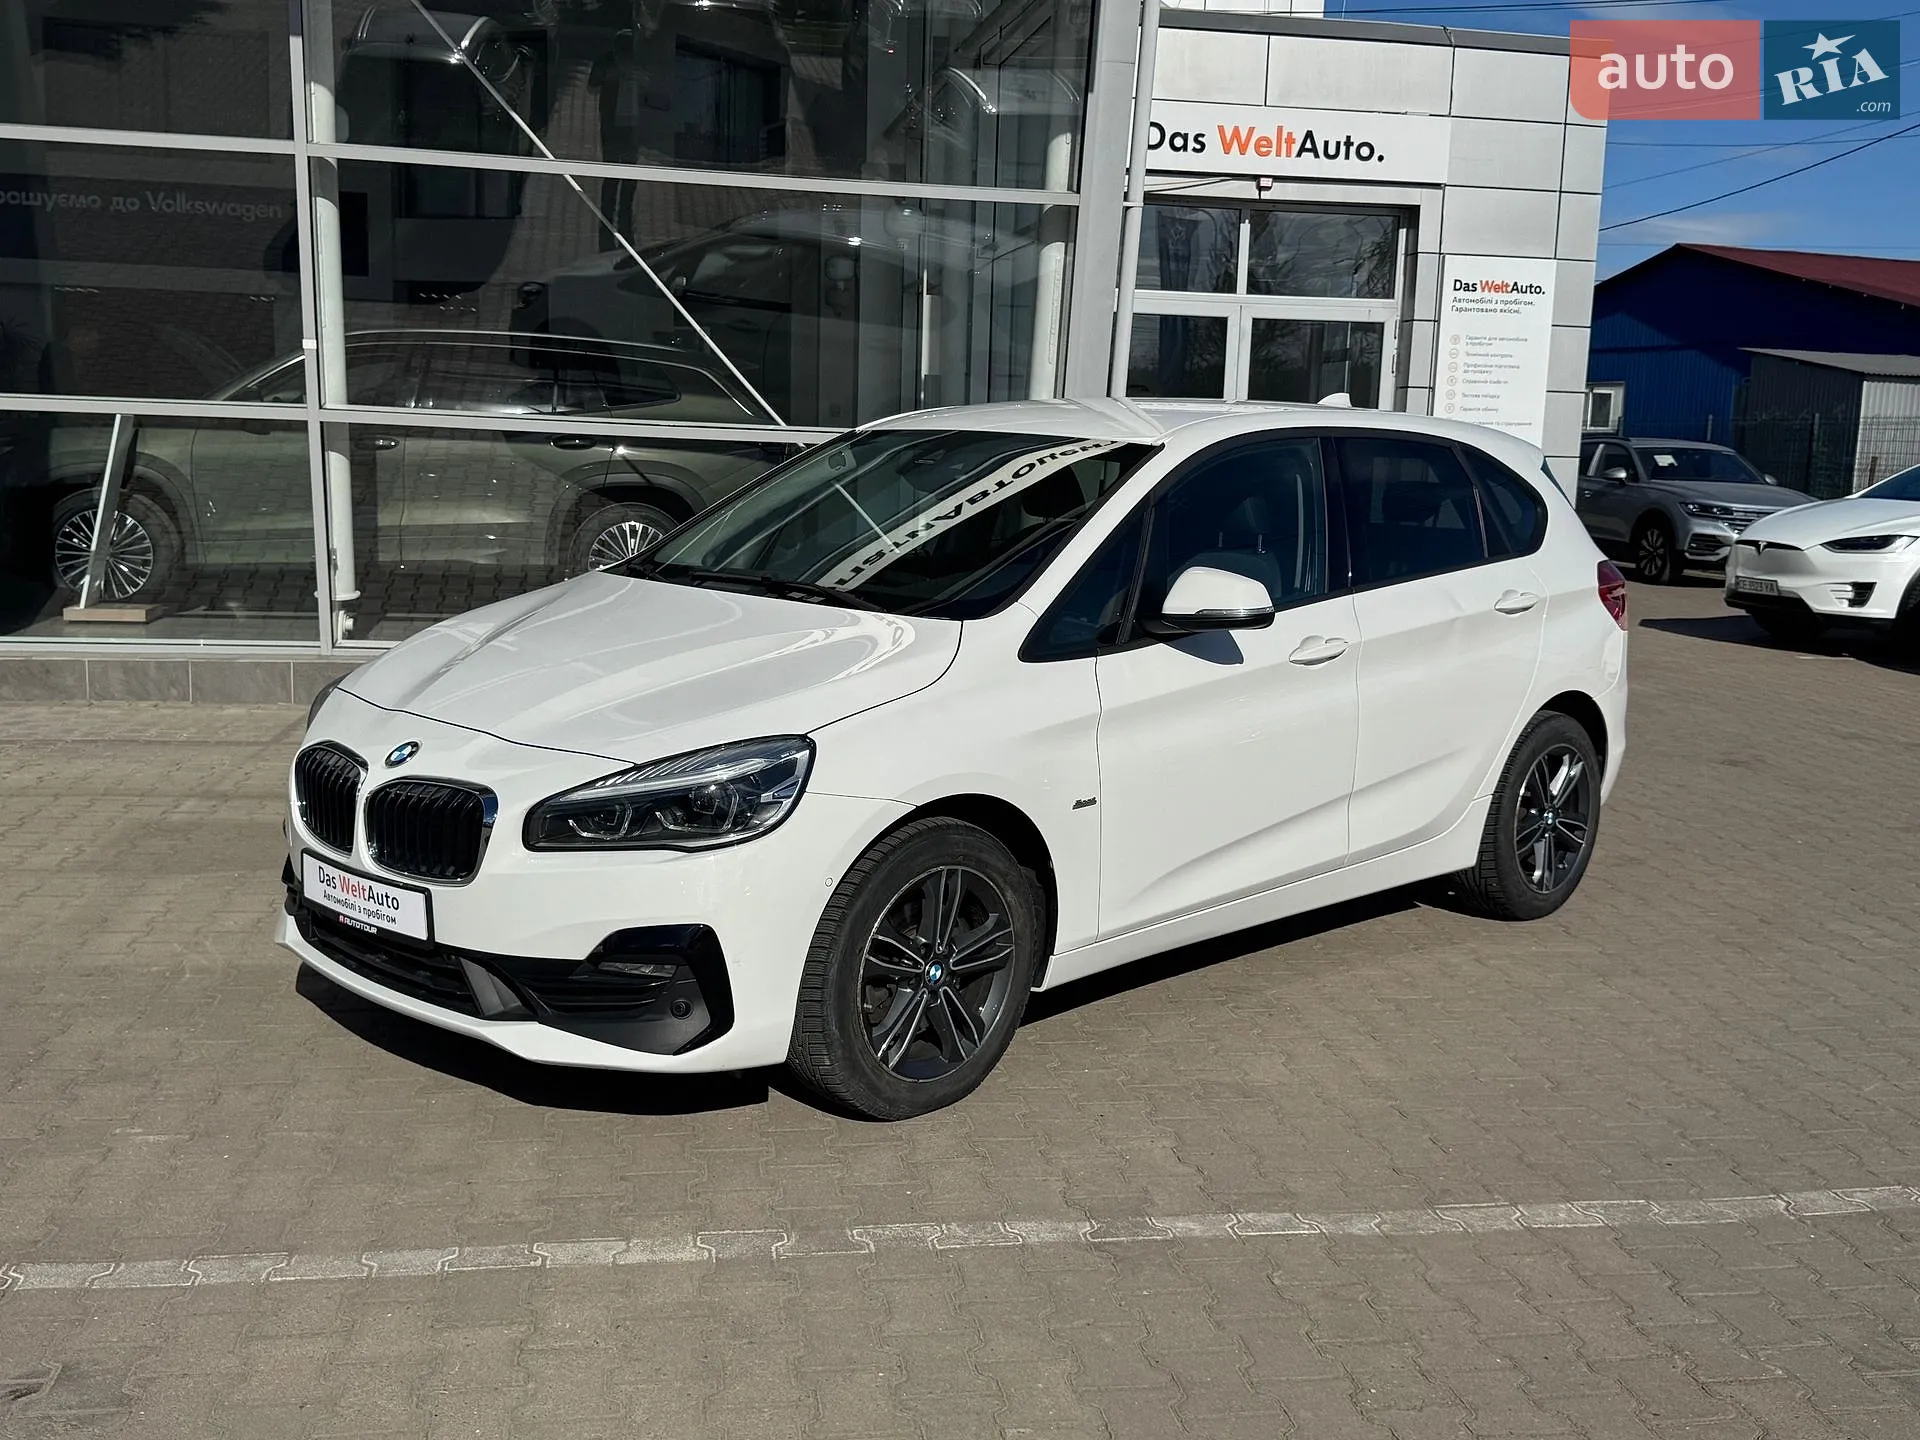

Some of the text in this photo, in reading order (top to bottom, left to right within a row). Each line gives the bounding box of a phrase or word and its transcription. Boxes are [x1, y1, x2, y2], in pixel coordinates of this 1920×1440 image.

[1147, 120, 1385, 163] Das WeltAuto.
[110, 196, 140, 213] до
[145, 191, 282, 222] Volkswagen
[1453, 279, 1546, 296] Das WeltAuto.
[318, 865, 400, 911] Das WeltAuto
[323, 889, 397, 925] Автомобілі з пробігом
